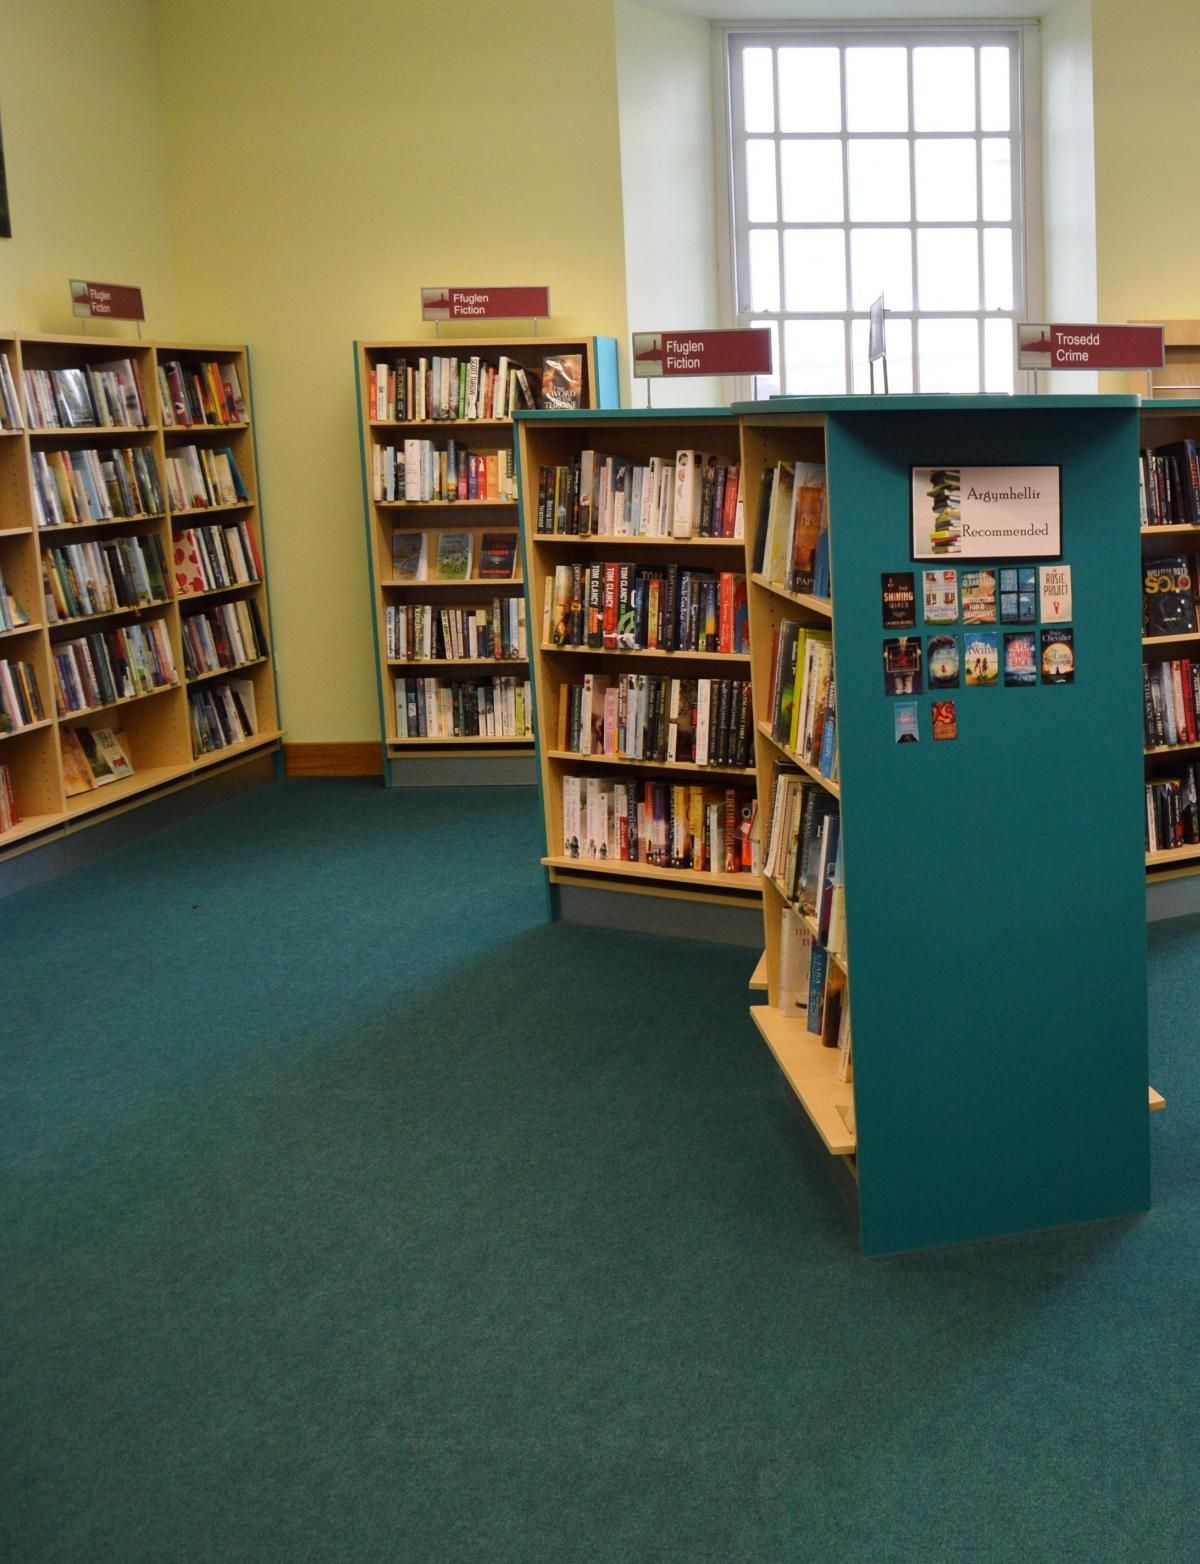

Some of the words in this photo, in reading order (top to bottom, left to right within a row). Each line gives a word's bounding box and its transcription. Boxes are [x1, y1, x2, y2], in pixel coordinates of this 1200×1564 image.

[453, 293, 489, 305] Ffuglen
[454, 305, 485, 315] Fiction
[1056, 333, 1100, 345] Trosedd
[666, 340, 704, 354] Ffuglen
[1056, 349, 1089, 361] Crime
[667, 356, 700, 369] Fiction
[967, 487, 1040, 502] Argymhellir
[962, 524, 1049, 537] Recommended
[592, 565, 600, 578] TOM
[606, 568, 614, 581] TOM
[620, 566, 628, 580] TOM
[1144, 575, 1191, 594] SOLO
[591, 581, 599, 605] CLANCY
[606, 583, 614, 608] CLANCY
[620, 580, 628, 603] CLANCY
[884, 592, 914, 602] SHINING
[680, 596, 688, 620] Coelho
[1042, 633, 1072, 642] Chevalier
